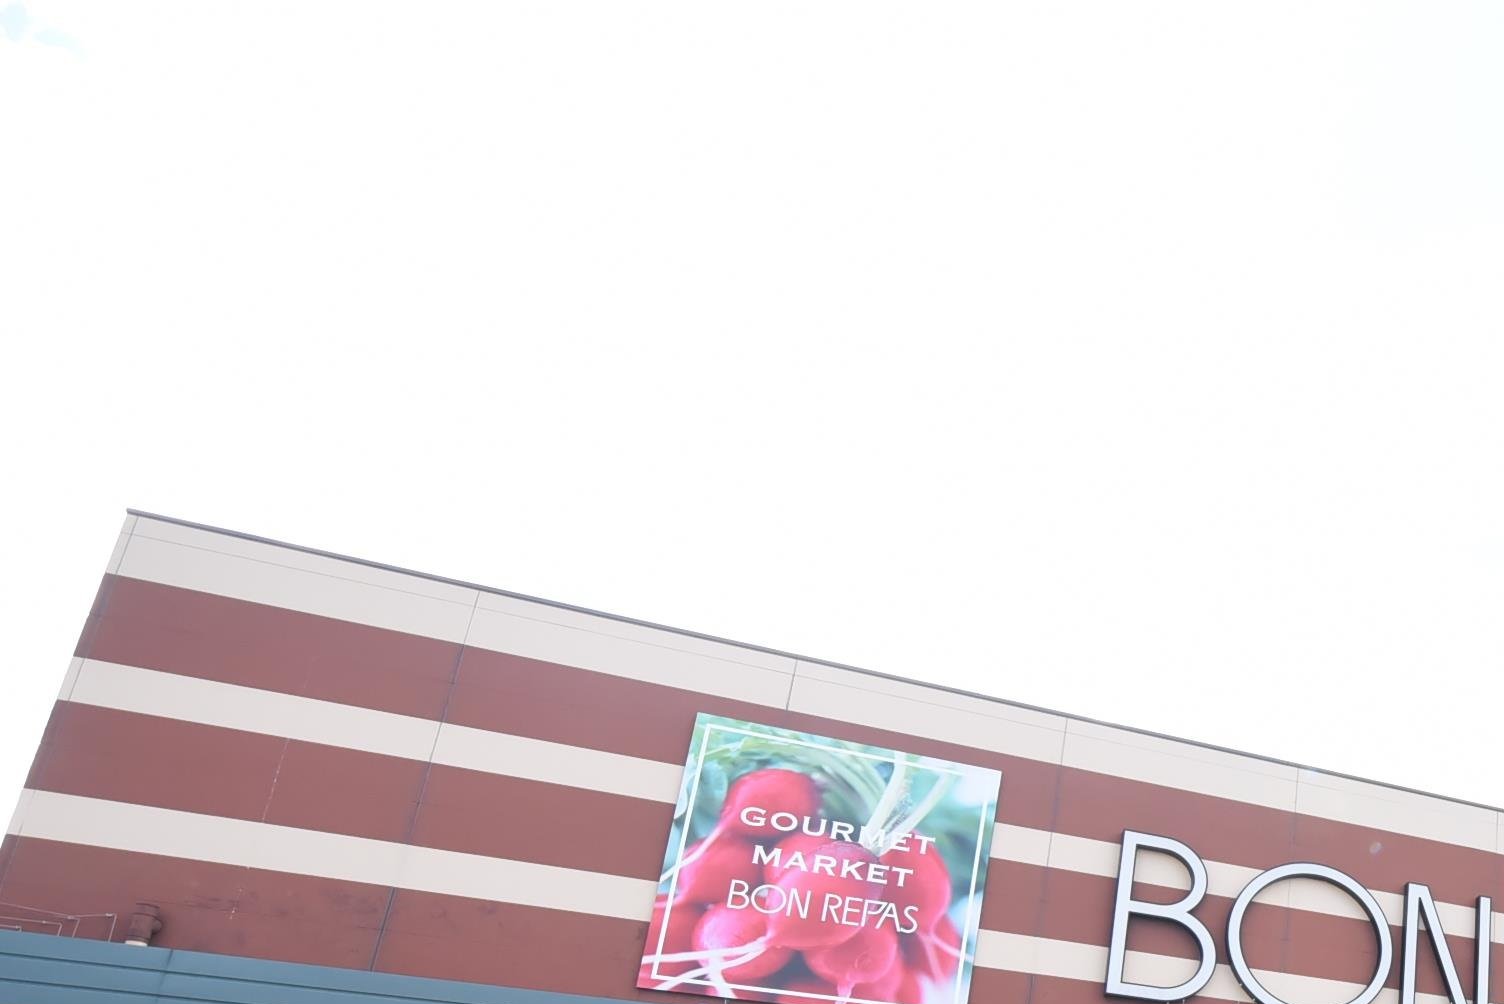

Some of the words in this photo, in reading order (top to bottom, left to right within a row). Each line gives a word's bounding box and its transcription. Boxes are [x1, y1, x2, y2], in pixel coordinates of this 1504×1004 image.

[740, 806, 936, 856] GOURMET
[751, 845, 915, 888] MARKET
[726, 879, 811, 919] BON
[821, 893, 920, 935] REPAS
